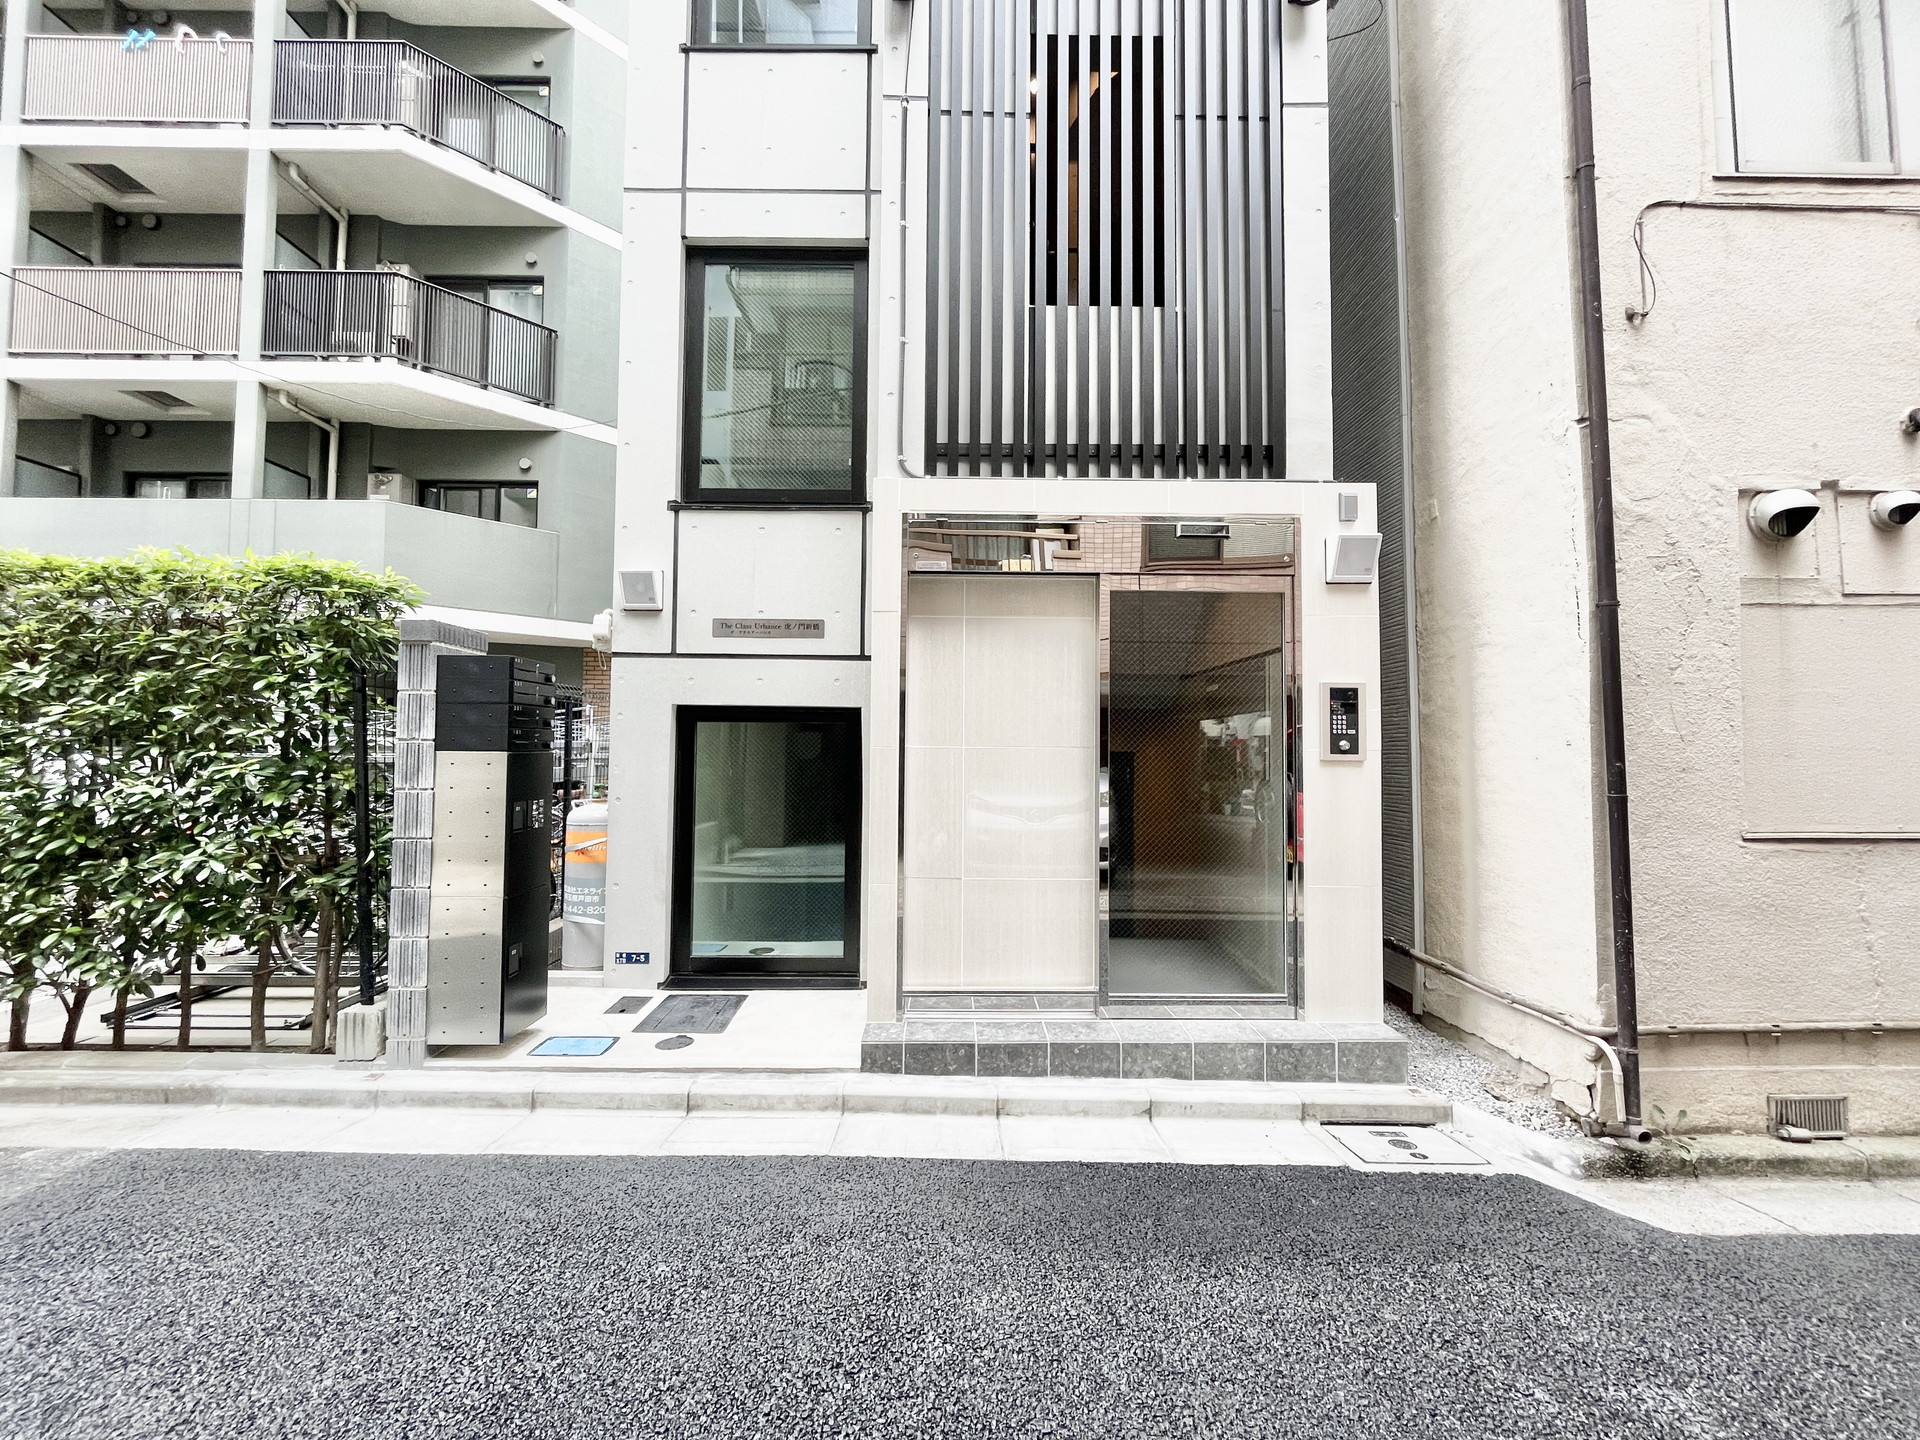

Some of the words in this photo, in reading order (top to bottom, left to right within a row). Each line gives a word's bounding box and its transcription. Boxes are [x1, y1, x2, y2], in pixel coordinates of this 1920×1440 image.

[720, 622, 733, 630] The
[735, 622, 752, 630] Class
[754, 622, 781, 630] Urbance
[631, 954, 646, 963] 7-5
